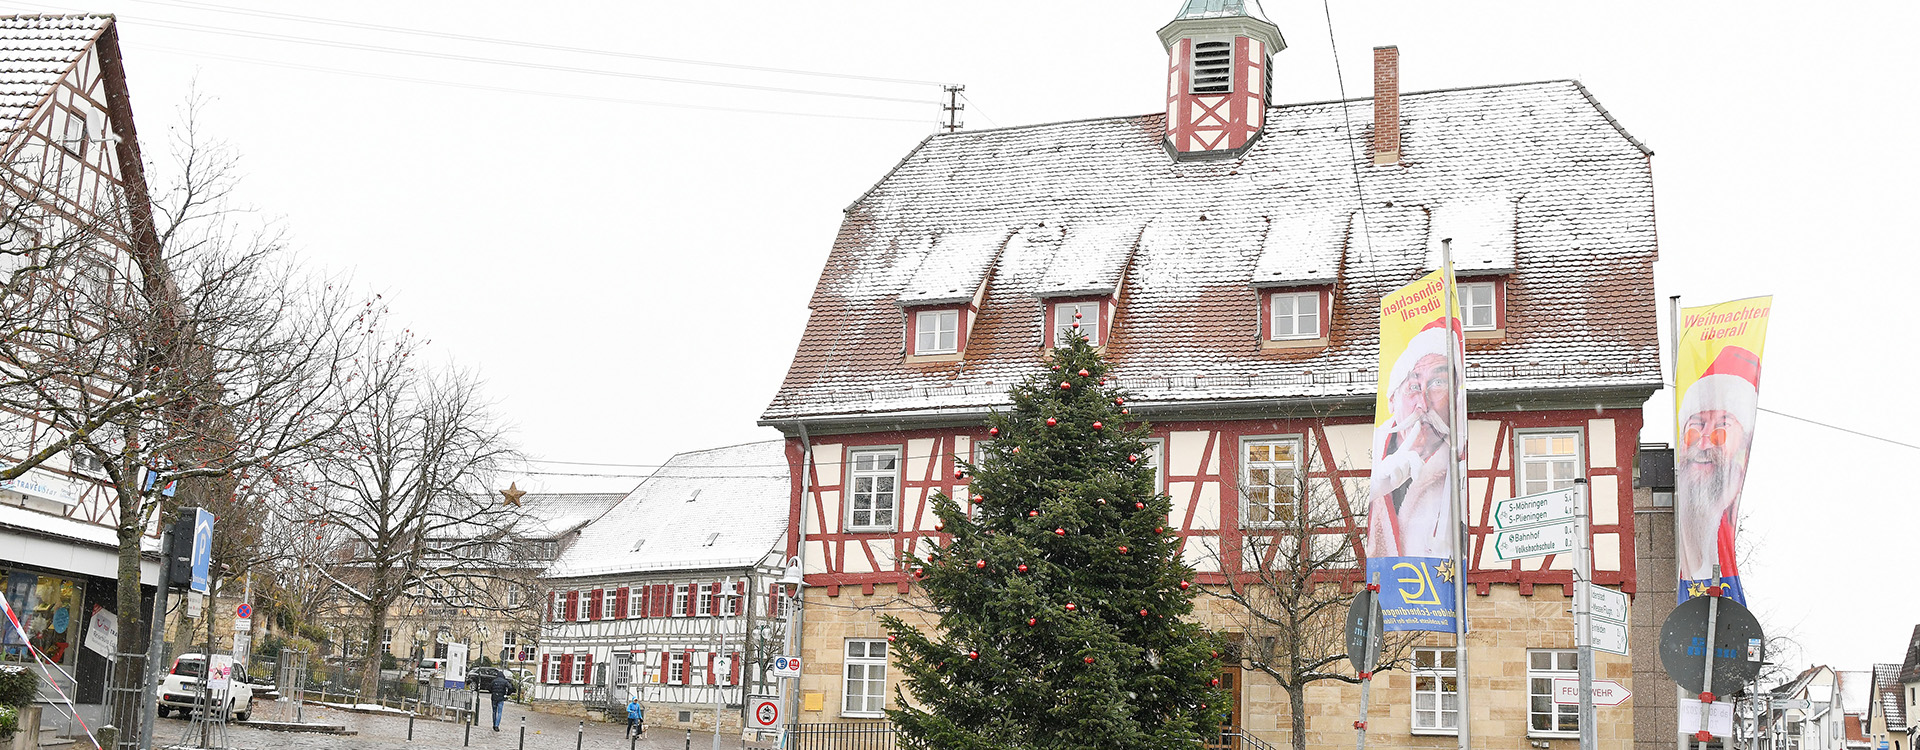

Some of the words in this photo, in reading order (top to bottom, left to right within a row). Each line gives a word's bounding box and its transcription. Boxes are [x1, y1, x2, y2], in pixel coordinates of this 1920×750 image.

[1684, 306, 1770, 328] Weihnachten
[1700, 321, 1748, 341] überall
[1508, 498, 1548, 512] S-Möhringen
[1508, 510, 1548, 524] S-Plieningen
[1515, 530, 1541, 543] Bahnhof
[198, 533, 207, 566] P
[1515, 540, 1556, 554] Volkshochschule
[1562, 687, 1614, 697] FEUWEHR
